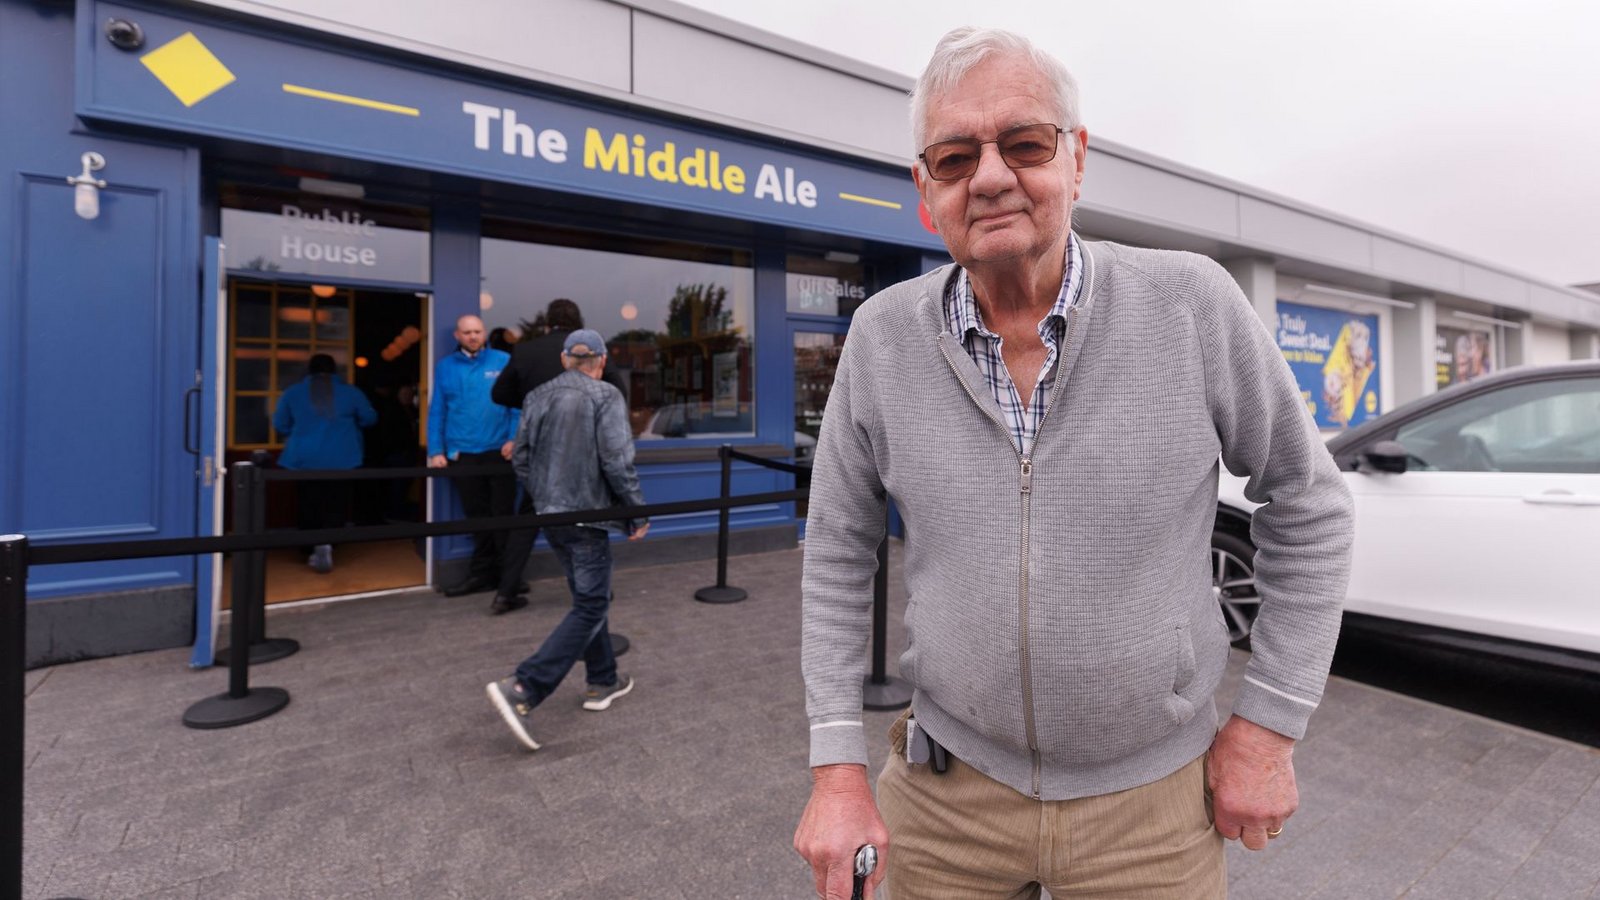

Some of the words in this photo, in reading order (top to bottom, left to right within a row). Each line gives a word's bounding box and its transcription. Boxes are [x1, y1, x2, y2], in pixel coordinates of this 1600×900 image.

[462, 101, 568, 164] The
[583, 127, 746, 194] Middle
[754, 163, 818, 208] Ale
[281, 204, 377, 236] Public
[280, 235, 377, 267] House
[824, 279, 866, 299] Sales
